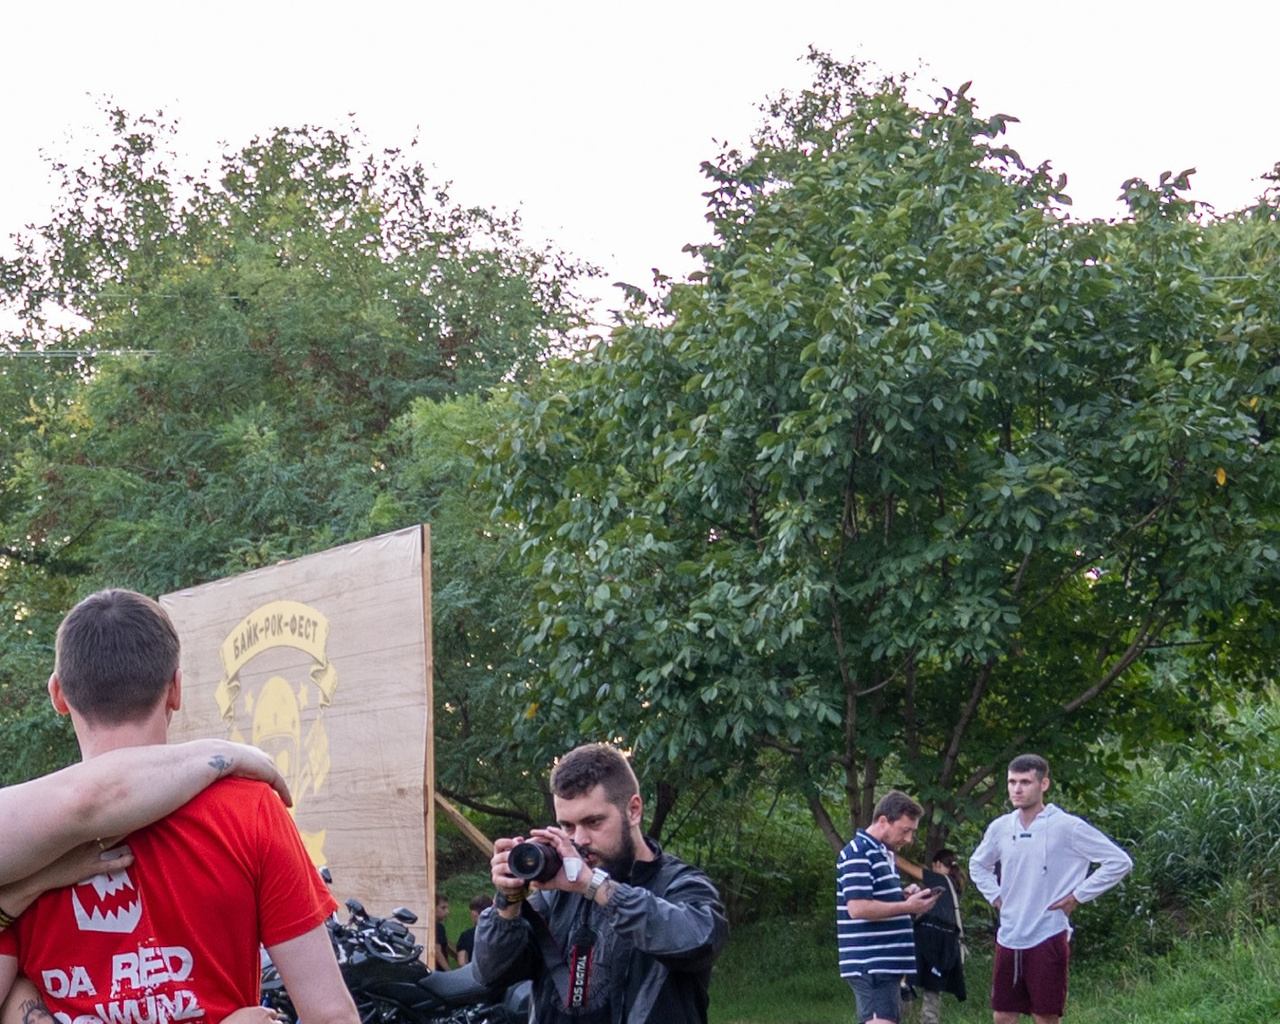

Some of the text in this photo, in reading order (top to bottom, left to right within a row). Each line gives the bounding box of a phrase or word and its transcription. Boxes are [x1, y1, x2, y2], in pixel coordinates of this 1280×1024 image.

[233, 613, 318, 661] БАЙК-РОК-ФЕСТ
[41, 945, 194, 999] DA RED
[573, 986, 584, 1007] EOS
